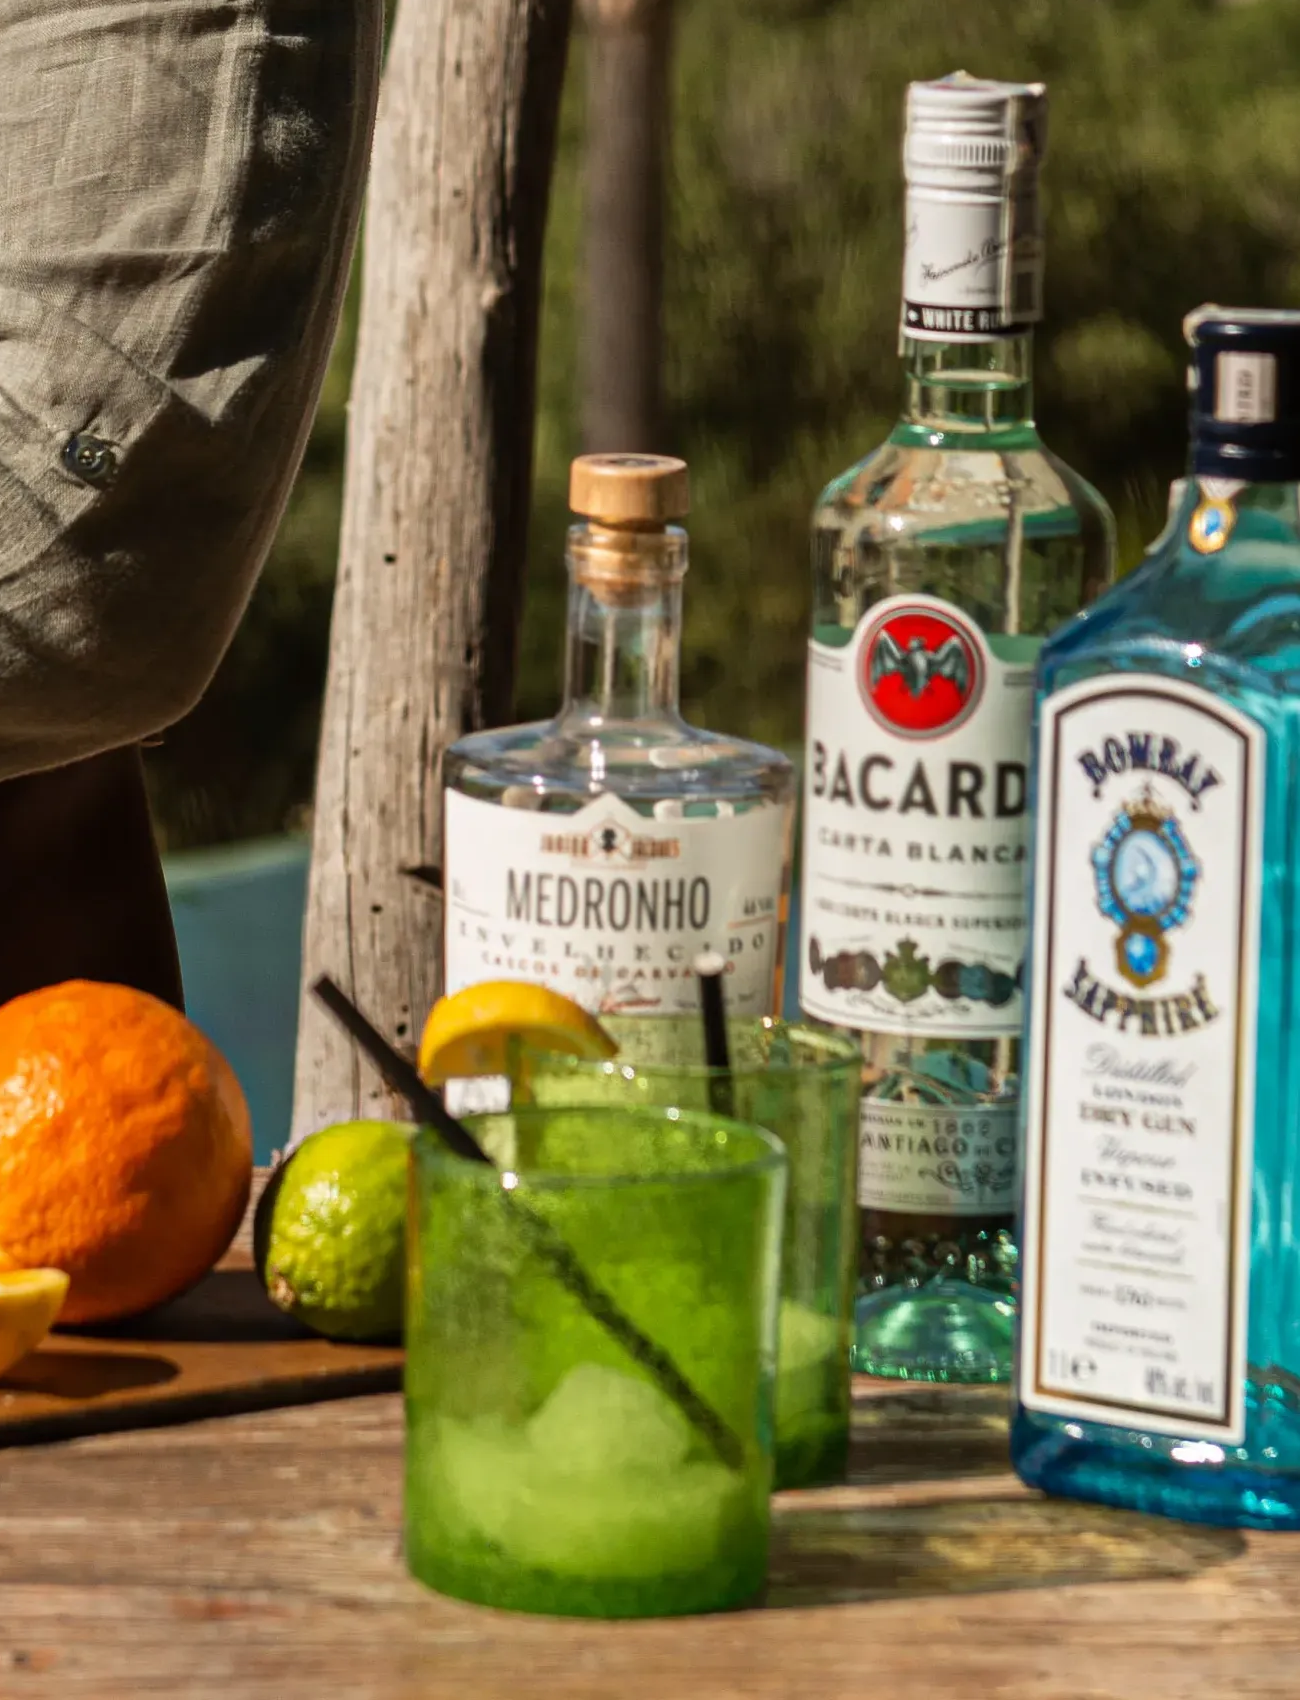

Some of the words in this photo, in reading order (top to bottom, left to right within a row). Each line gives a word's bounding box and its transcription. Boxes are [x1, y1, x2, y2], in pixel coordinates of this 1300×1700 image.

[921, 306, 975, 333] WHITE
[812, 738, 1028, 820] BACARD
[1076, 730, 1225, 805] BOMBAY
[818, 826, 894, 858] CARTA
[506, 867, 711, 933] MEDRONHO
[1063, 957, 1222, 1038] SAPPHIRE
[860, 1131, 969, 1158] ANTIAGO
